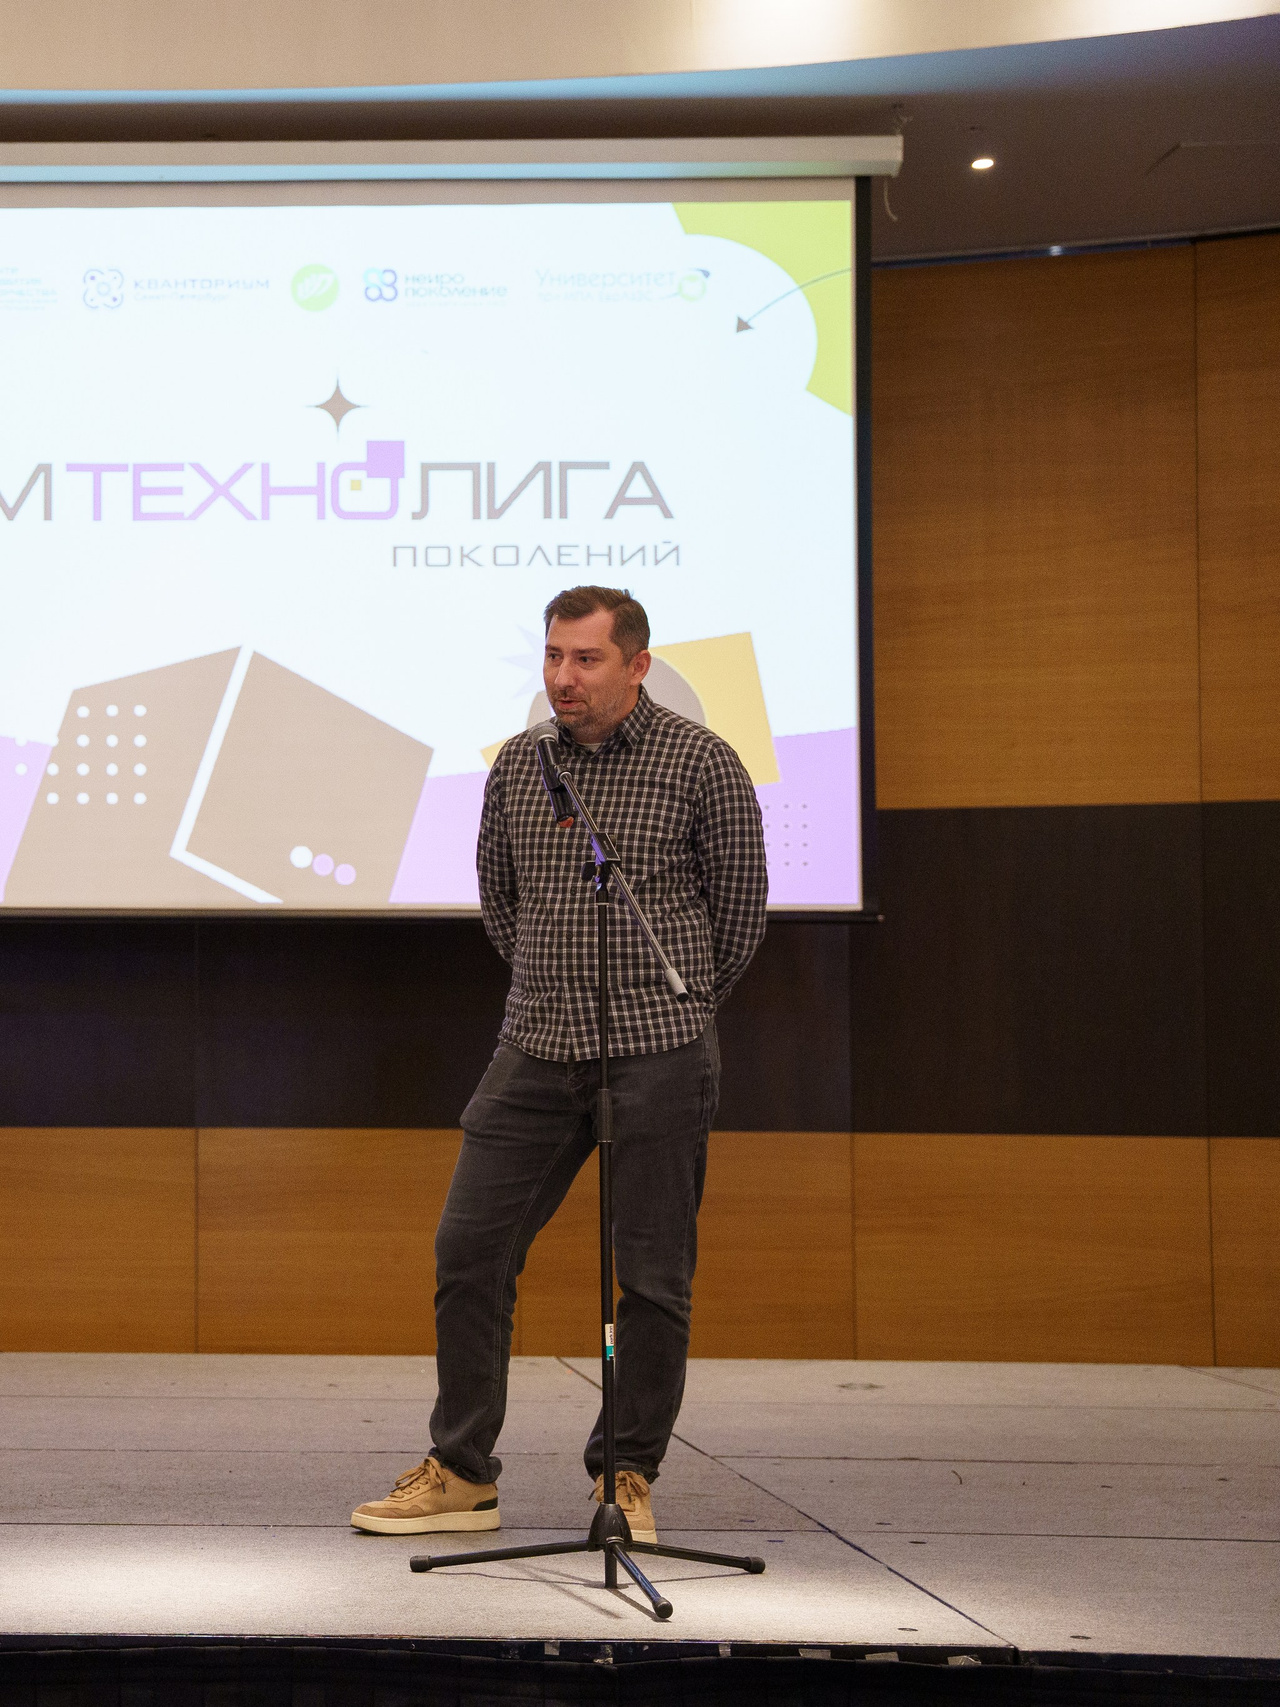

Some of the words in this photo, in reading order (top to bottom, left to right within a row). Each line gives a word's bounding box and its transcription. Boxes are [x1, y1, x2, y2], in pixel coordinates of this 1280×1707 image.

[133, 279, 270, 290] КВАНТОРИУМ
[535, 268, 676, 291] Университет
[393, 540, 680, 568] ПОКОЛЕНИЙ
